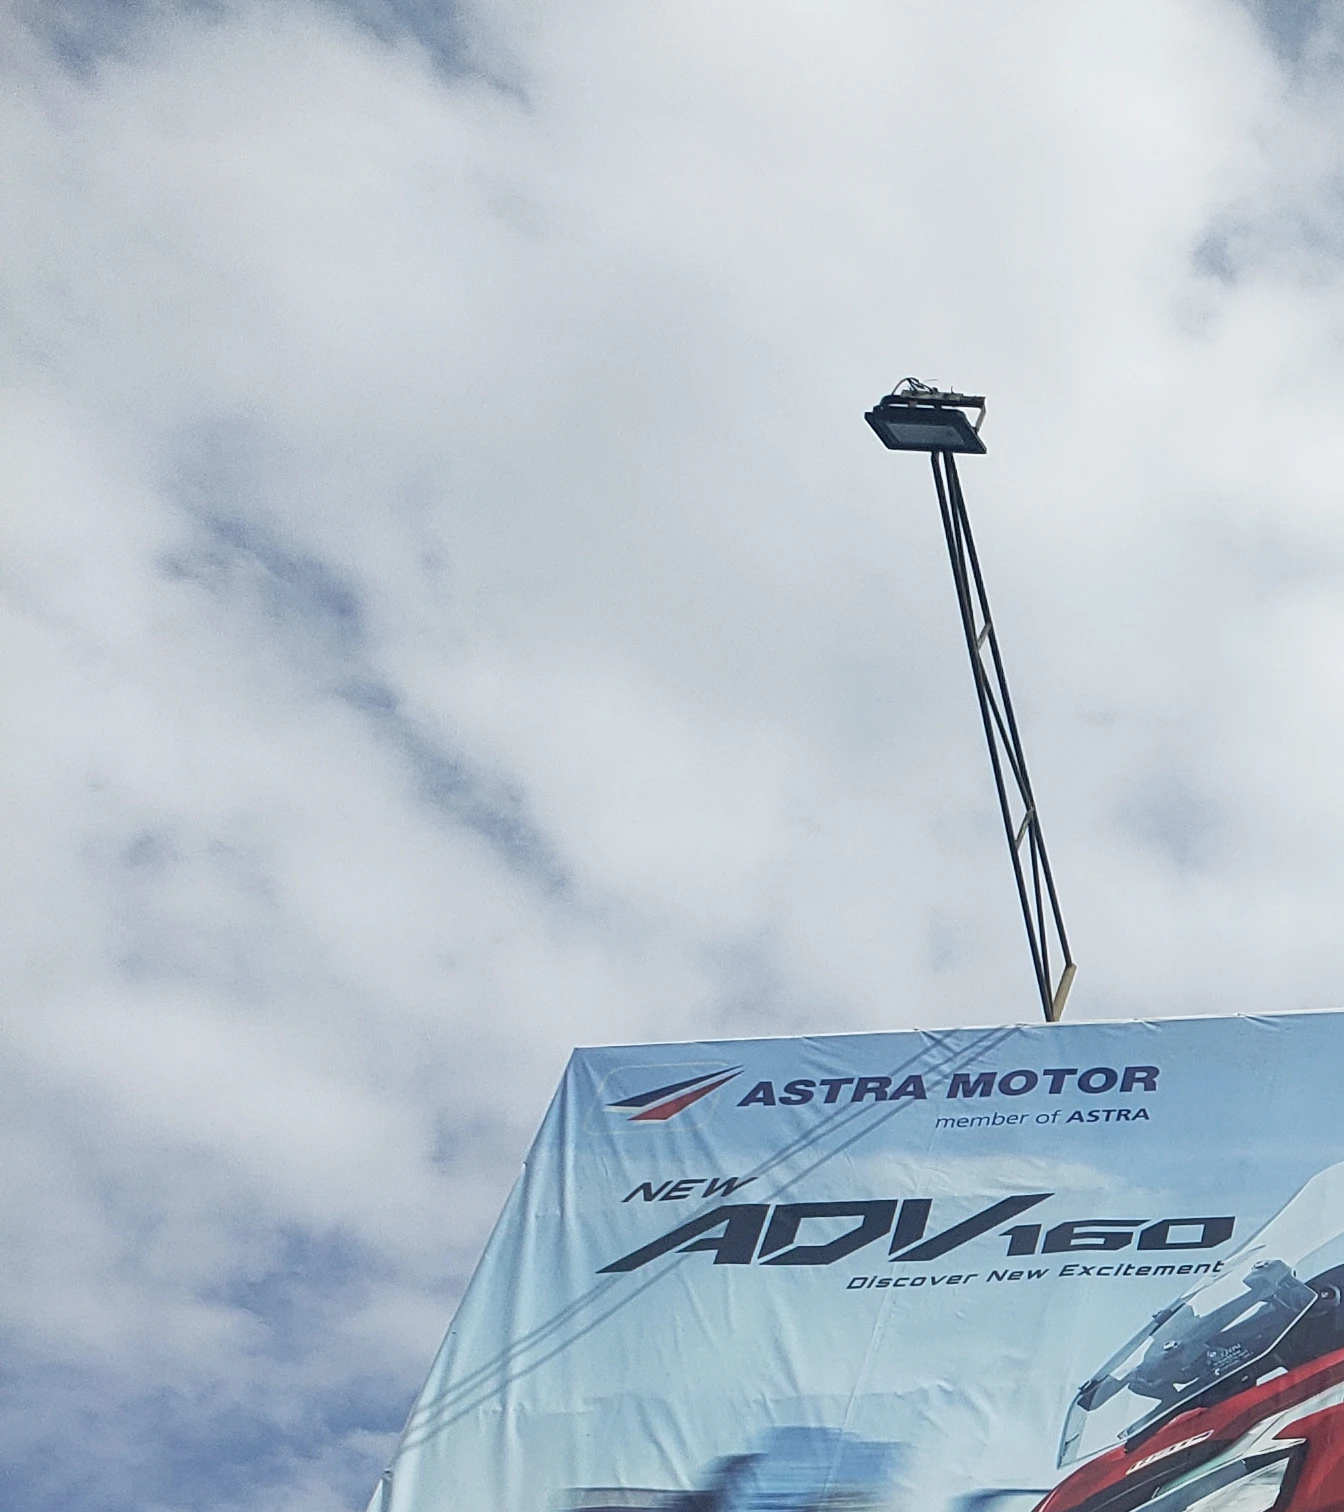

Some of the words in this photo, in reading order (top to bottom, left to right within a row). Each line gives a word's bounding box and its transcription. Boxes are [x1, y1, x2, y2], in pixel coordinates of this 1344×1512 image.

[737, 1075, 927, 1107] ASTRA
[946, 1066, 1160, 1098] MOTOR
[935, 1110, 1028, 1130] member
[1033, 1109, 1062, 1126] of
[1065, 1108, 1151, 1124] ASTRA
[622, 1176, 758, 1203] NEW
[846, 1272, 977, 1290] Discover
[986, 1267, 1049, 1283] New
[1058, 1260, 1226, 1278] Excitement
